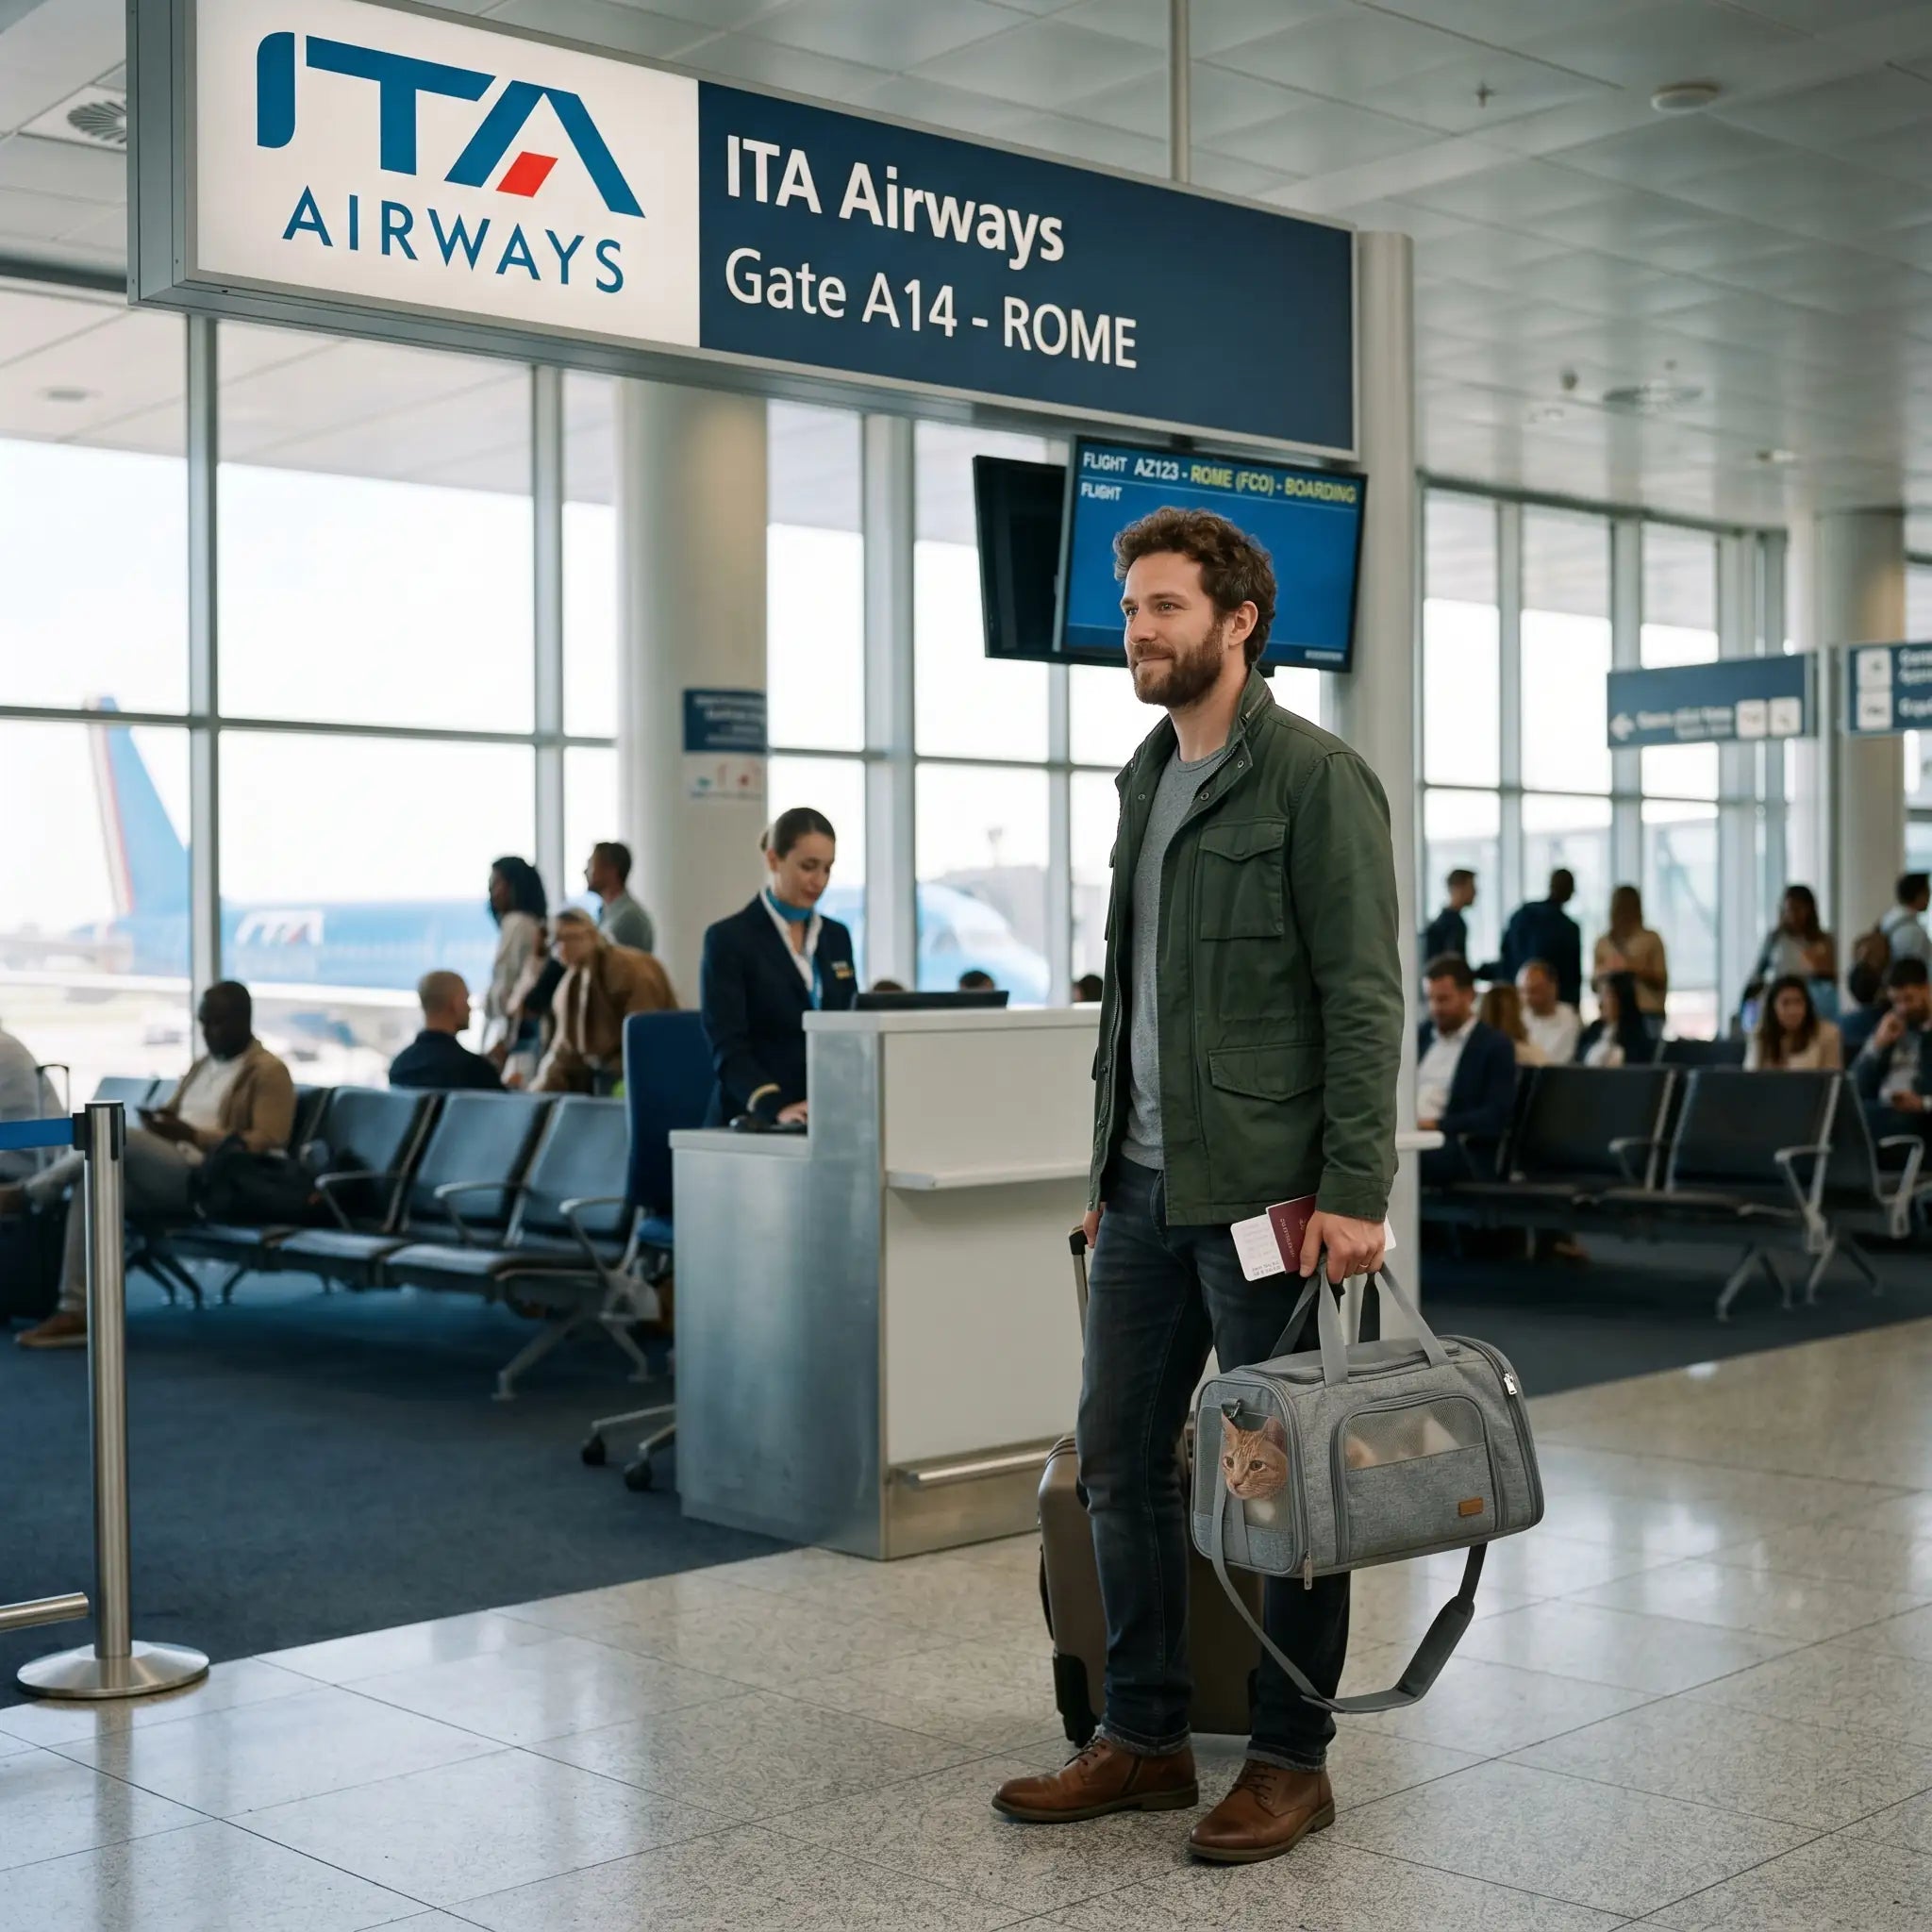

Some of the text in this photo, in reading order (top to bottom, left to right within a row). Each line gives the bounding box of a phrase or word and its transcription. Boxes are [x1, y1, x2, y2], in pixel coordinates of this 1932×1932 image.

[256, 31, 646, 218] ITA
[283, 186, 625, 293] AIRWAYS
[727, 135, 1064, 271] ITA Airways
[725, 248, 846, 318] Gate
[862, 273, 957, 337] A14
[1004, 296, 1137, 369] ROME
[1080, 482, 1122, 501] FLIGHT
[1083, 452, 1127, 472] FLIGHT
[1134, 458, 1179, 480] AZ123
[1191, 464, 1233, 489] ROME
[1236, 471, 1274, 497] (FCO)
[1284, 476, 1357, 504] BOARDING
